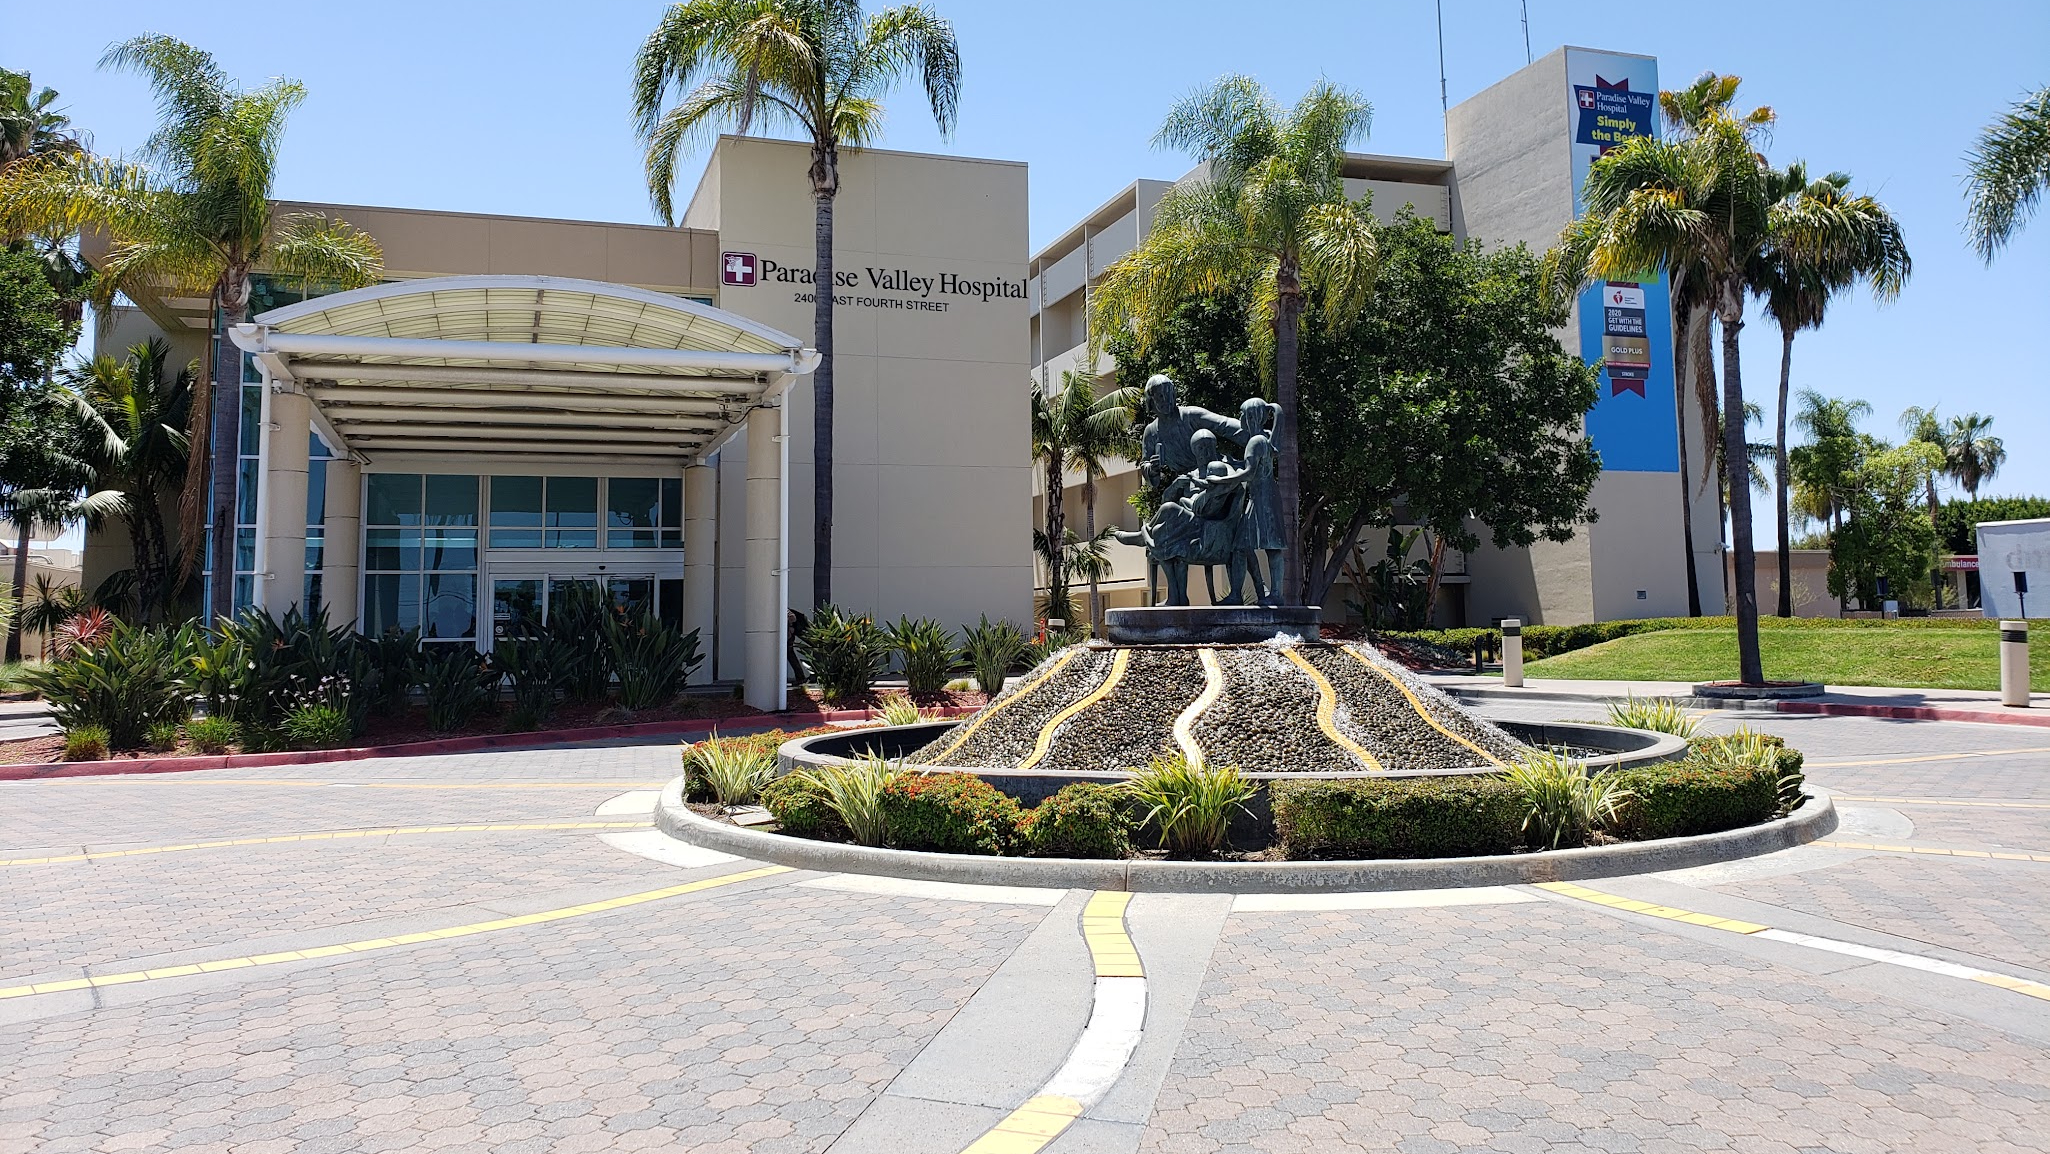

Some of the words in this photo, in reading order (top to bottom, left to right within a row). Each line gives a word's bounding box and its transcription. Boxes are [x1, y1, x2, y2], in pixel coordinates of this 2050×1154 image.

[1596, 91, 1627, 104] Paradise
[1627, 94, 1650, 108] Valley
[1596, 101, 1627, 114] Hospital
[1596, 115, 1637, 133] Simply
[1591, 129, 1611, 141] the
[1613, 131, 1637, 142] Be
[760, 259, 859, 288] Parase
[865, 267, 934, 298] Valley
[939, 272, 1028, 303] Hospital
[831, 295, 854, 306] AST
[856, 297, 903, 309] FOURTH
[906, 300, 950, 312] STREET
[1608, 309, 1622, 317] 2020
[1610, 346, 1628, 354] GOLD
[1628, 347, 1643, 355] PLUS
[1943, 559, 1979, 568] mbulance
